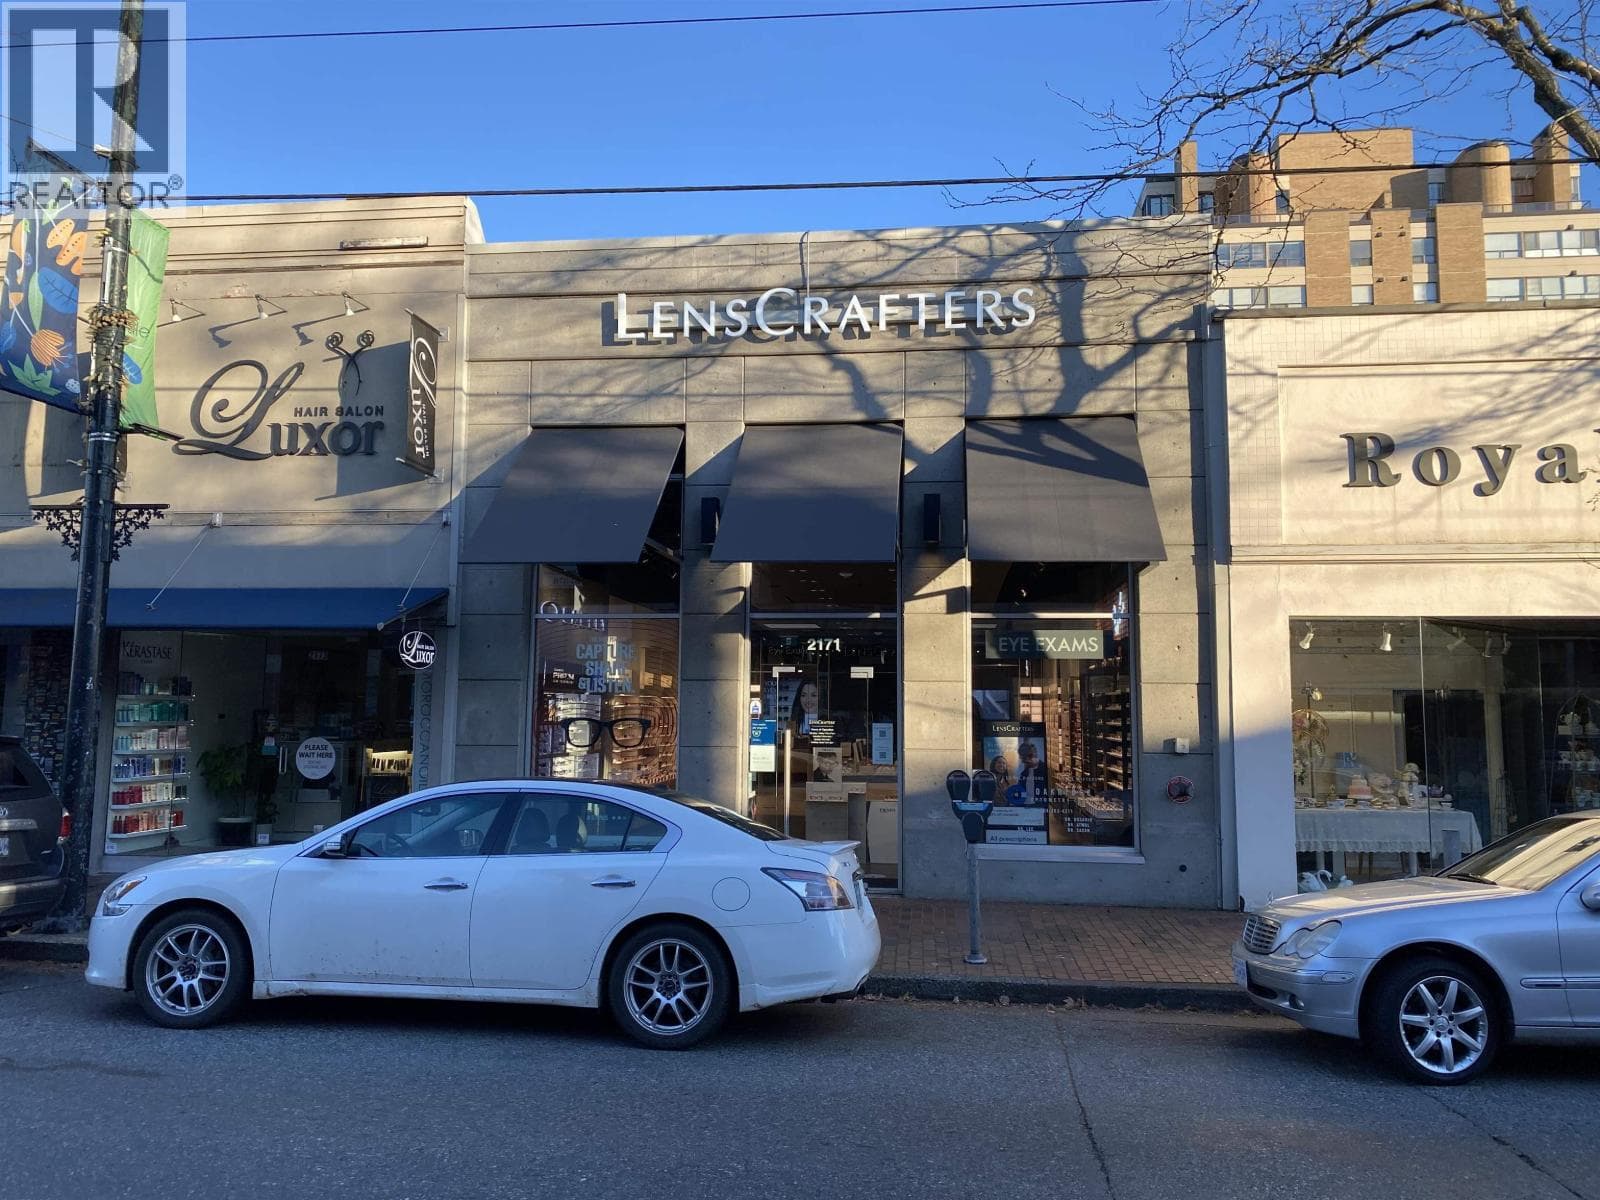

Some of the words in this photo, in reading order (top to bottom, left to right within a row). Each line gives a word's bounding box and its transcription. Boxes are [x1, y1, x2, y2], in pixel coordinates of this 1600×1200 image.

[409, 327, 438, 459] Luxor
[171, 358, 385, 462] Luxor
[294, 406, 329, 418] HAIR
[335, 405, 385, 417] SALON
[1339, 430, 1600, 497] Roya
[400, 631, 435, 664] Luxor
[807, 638, 841, 652] 2171
[999, 637, 1030, 652] EYE
[1036, 636, 1099, 652] EXAMS
